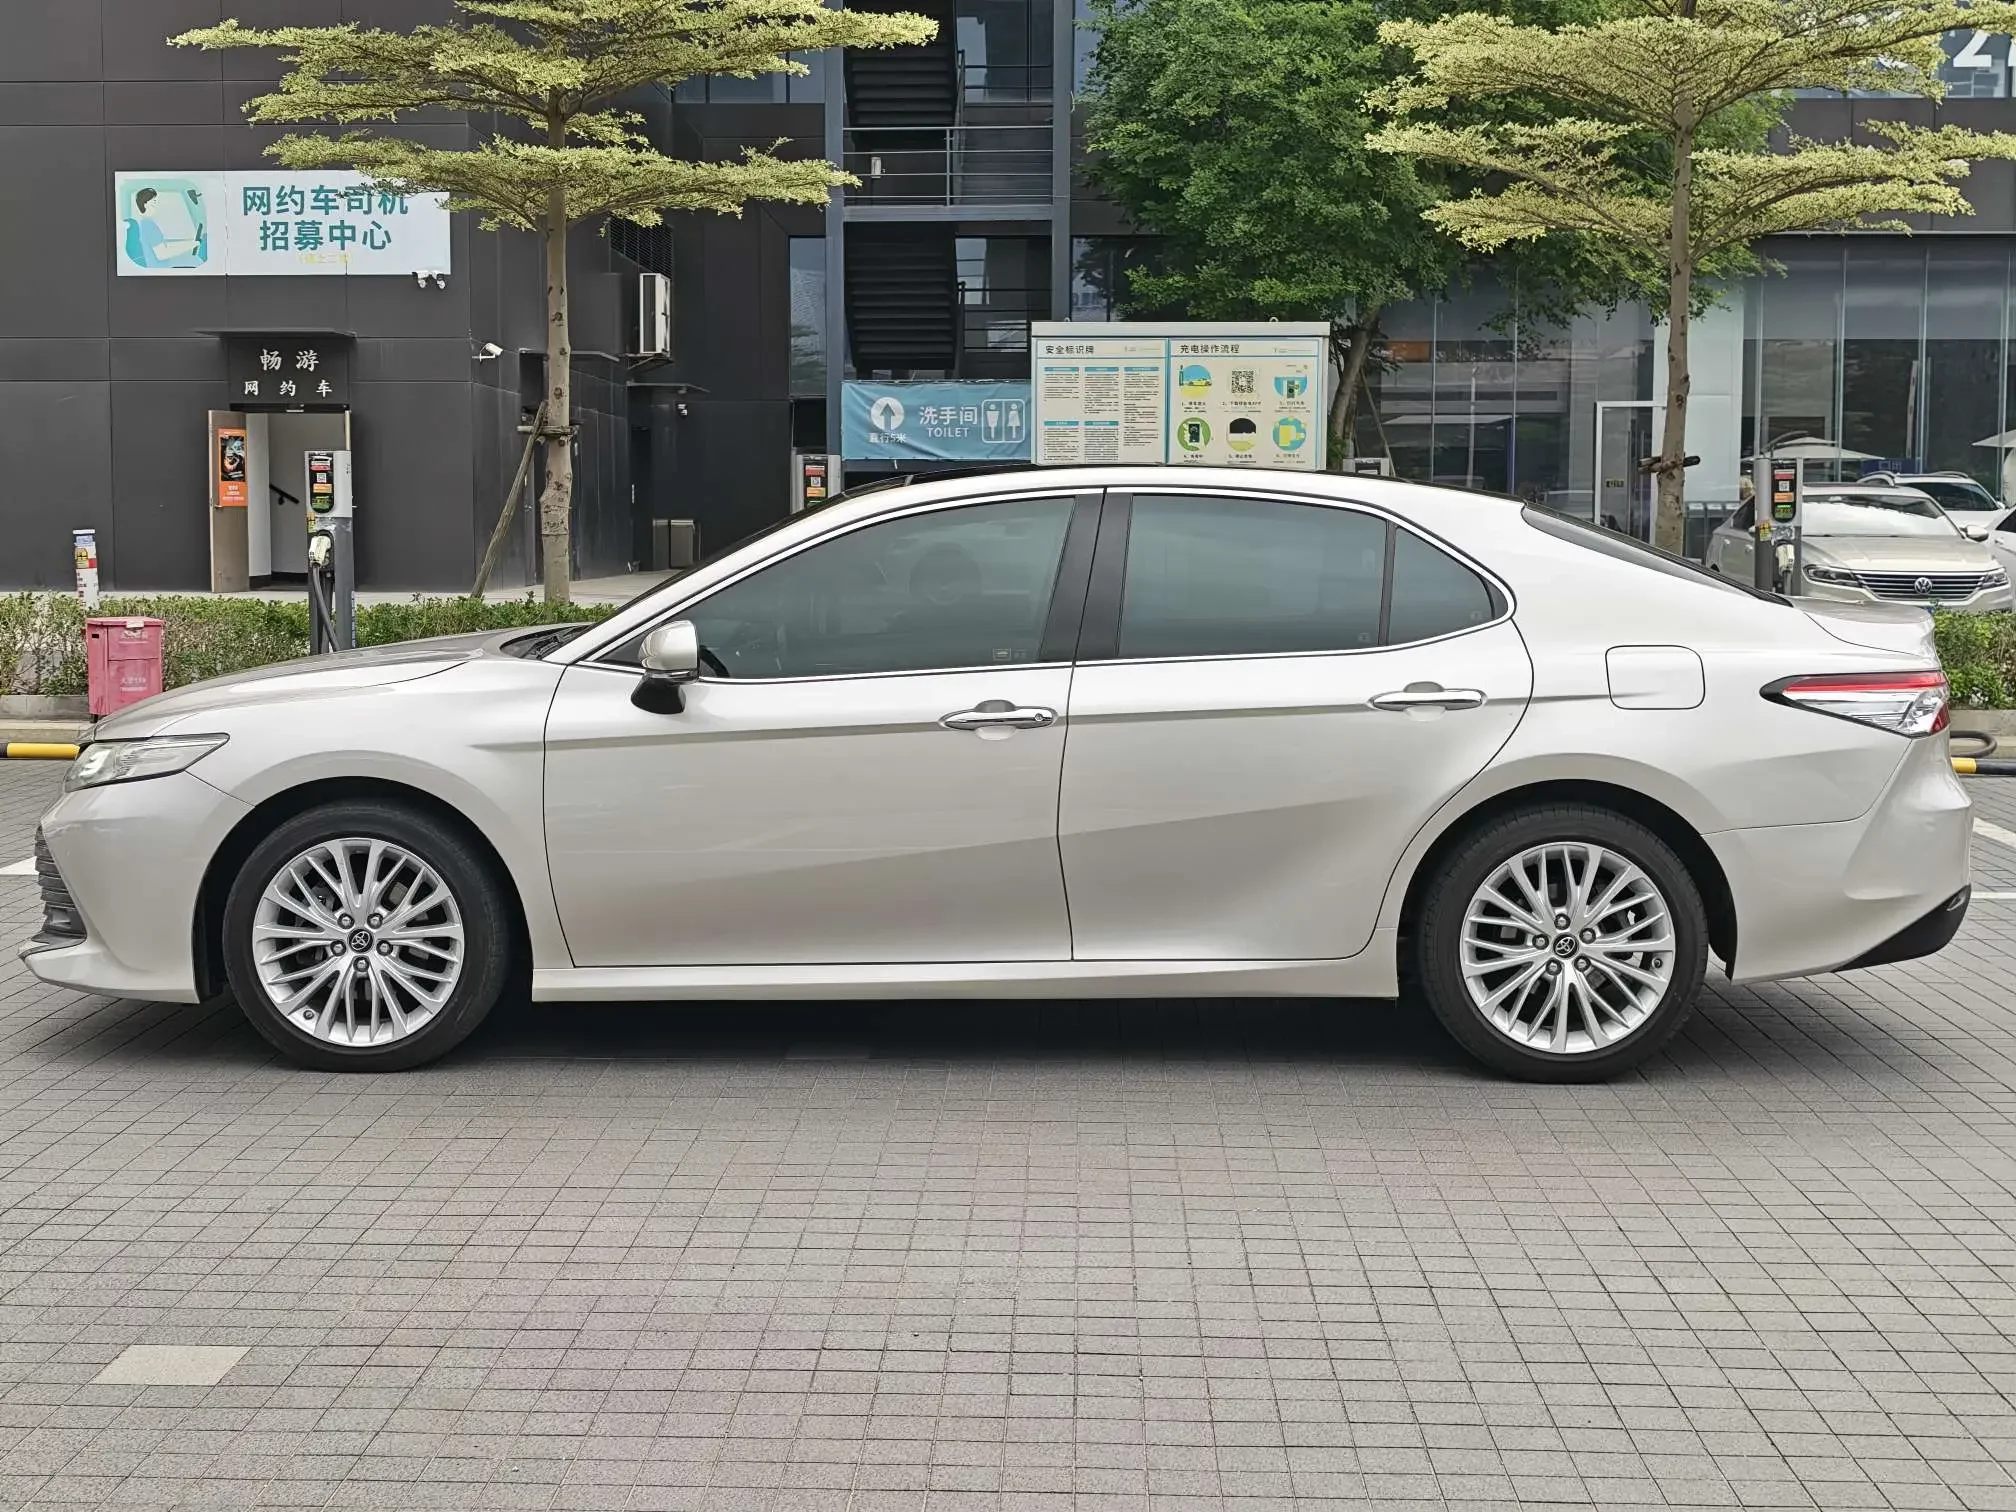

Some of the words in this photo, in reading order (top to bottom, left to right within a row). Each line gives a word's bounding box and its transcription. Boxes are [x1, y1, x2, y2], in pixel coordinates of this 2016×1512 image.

[243, 185, 408, 216] 网约车司机
[260, 220, 392, 251] 招募中心
[1045, 345, 1095, 355] 安全标识牌
[1180, 344, 1240, 354] 充电操作流程
[260, 349, 320, 371] 畅游
[244, 379, 333, 397] 网约车
[919, 406, 978, 425] 洗手间
[927, 427, 970, 438] TOILET
